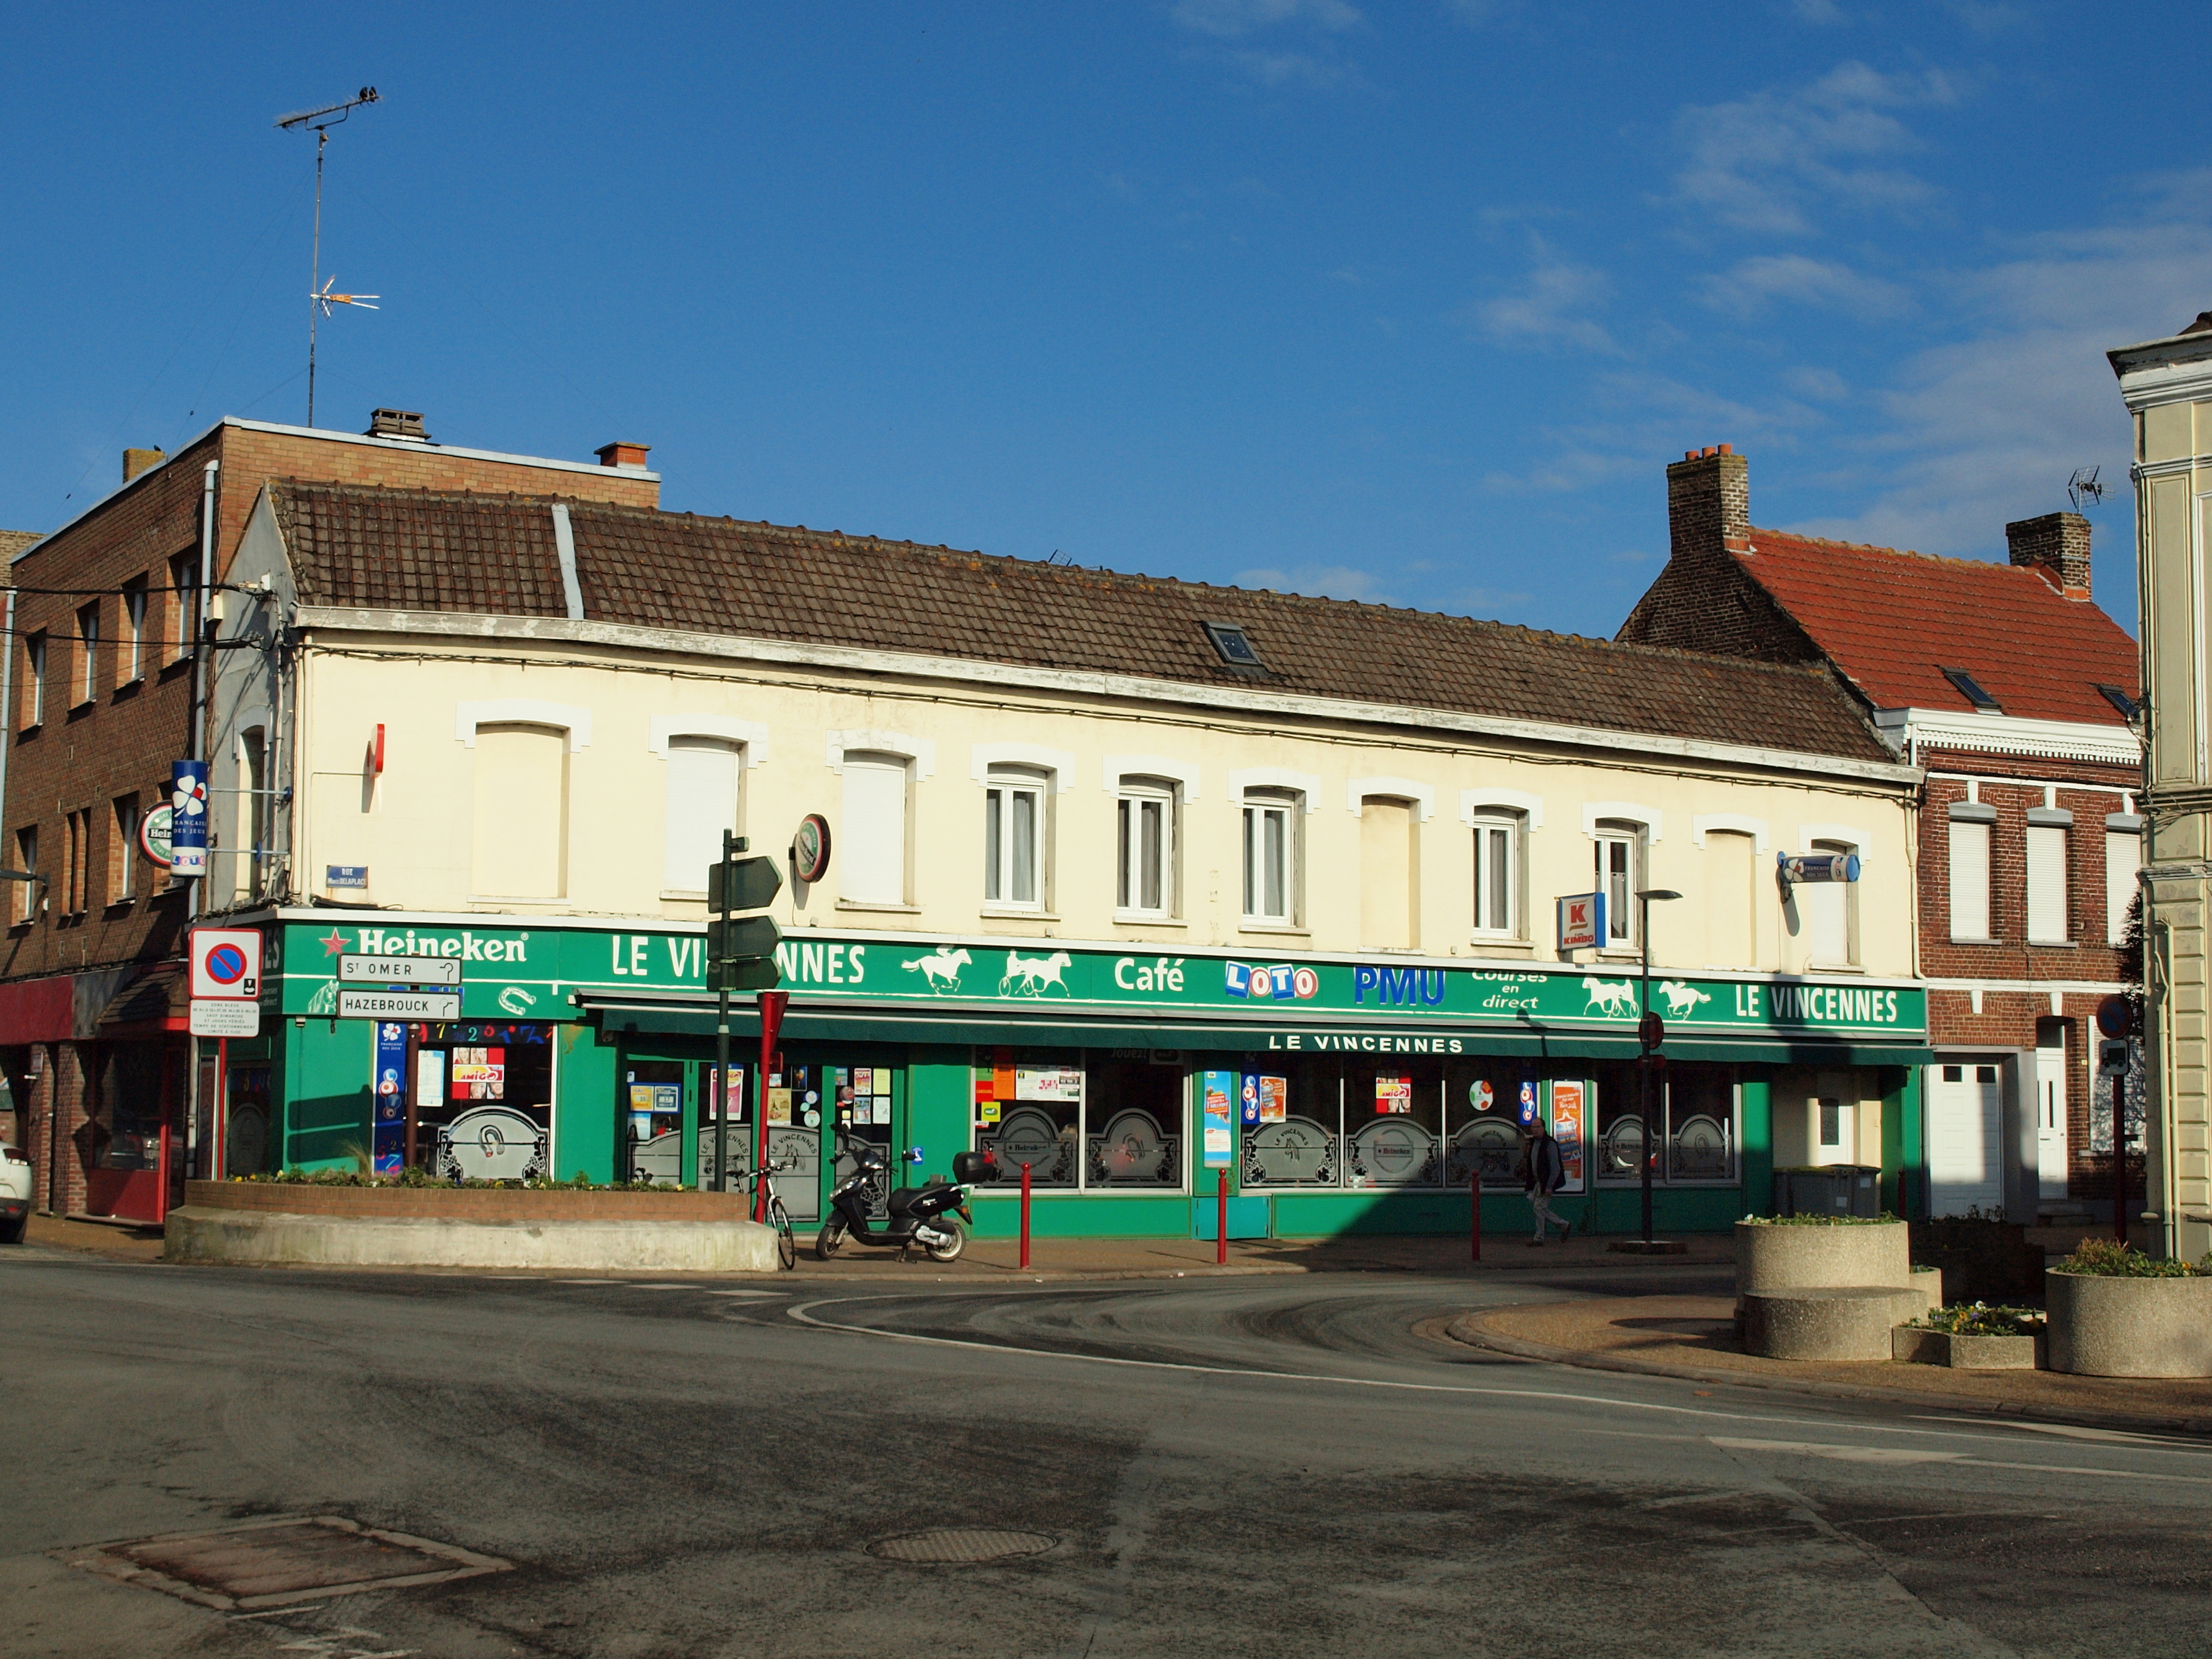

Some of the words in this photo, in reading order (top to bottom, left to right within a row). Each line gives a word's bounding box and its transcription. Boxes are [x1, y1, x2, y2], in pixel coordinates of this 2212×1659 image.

[150, 829, 172, 838] Hein
[172, 855, 206, 866] LOTO
[1571, 904, 1586, 923] K
[358, 929, 527, 962] Heineken
[1564, 934, 1594, 945] KIMBO
[612, 935, 648, 976] LE
[667, 938, 866, 983] VINNES
[369, 964, 411, 975] OMER
[1114, 958, 1185, 991] Café
[1471, 969, 1548, 983] Courses
[1225, 961, 1318, 1000] LOTO
[1353, 966, 1446, 1006] PMU
[1502, 984, 1519, 994] en
[345, 999, 428, 1012] HAZEBROUCK
[1482, 994, 1539, 1010] direct
[1735, 984, 1759, 1017] LE
[1771, 987, 1897, 1023] VINCENNES
[1268, 1035, 1301, 1050] LE
[1314, 1036, 1463, 1053] VINCENNES
[460, 1070, 497, 1081] AMIGO
[1381, 1088, 1406, 1097] AMIGO
[771, 1144, 778, 1154] LE
[778, 1133, 817, 1154] VINCENNES
[1280, 1128, 1309, 1146] VINCENNES
